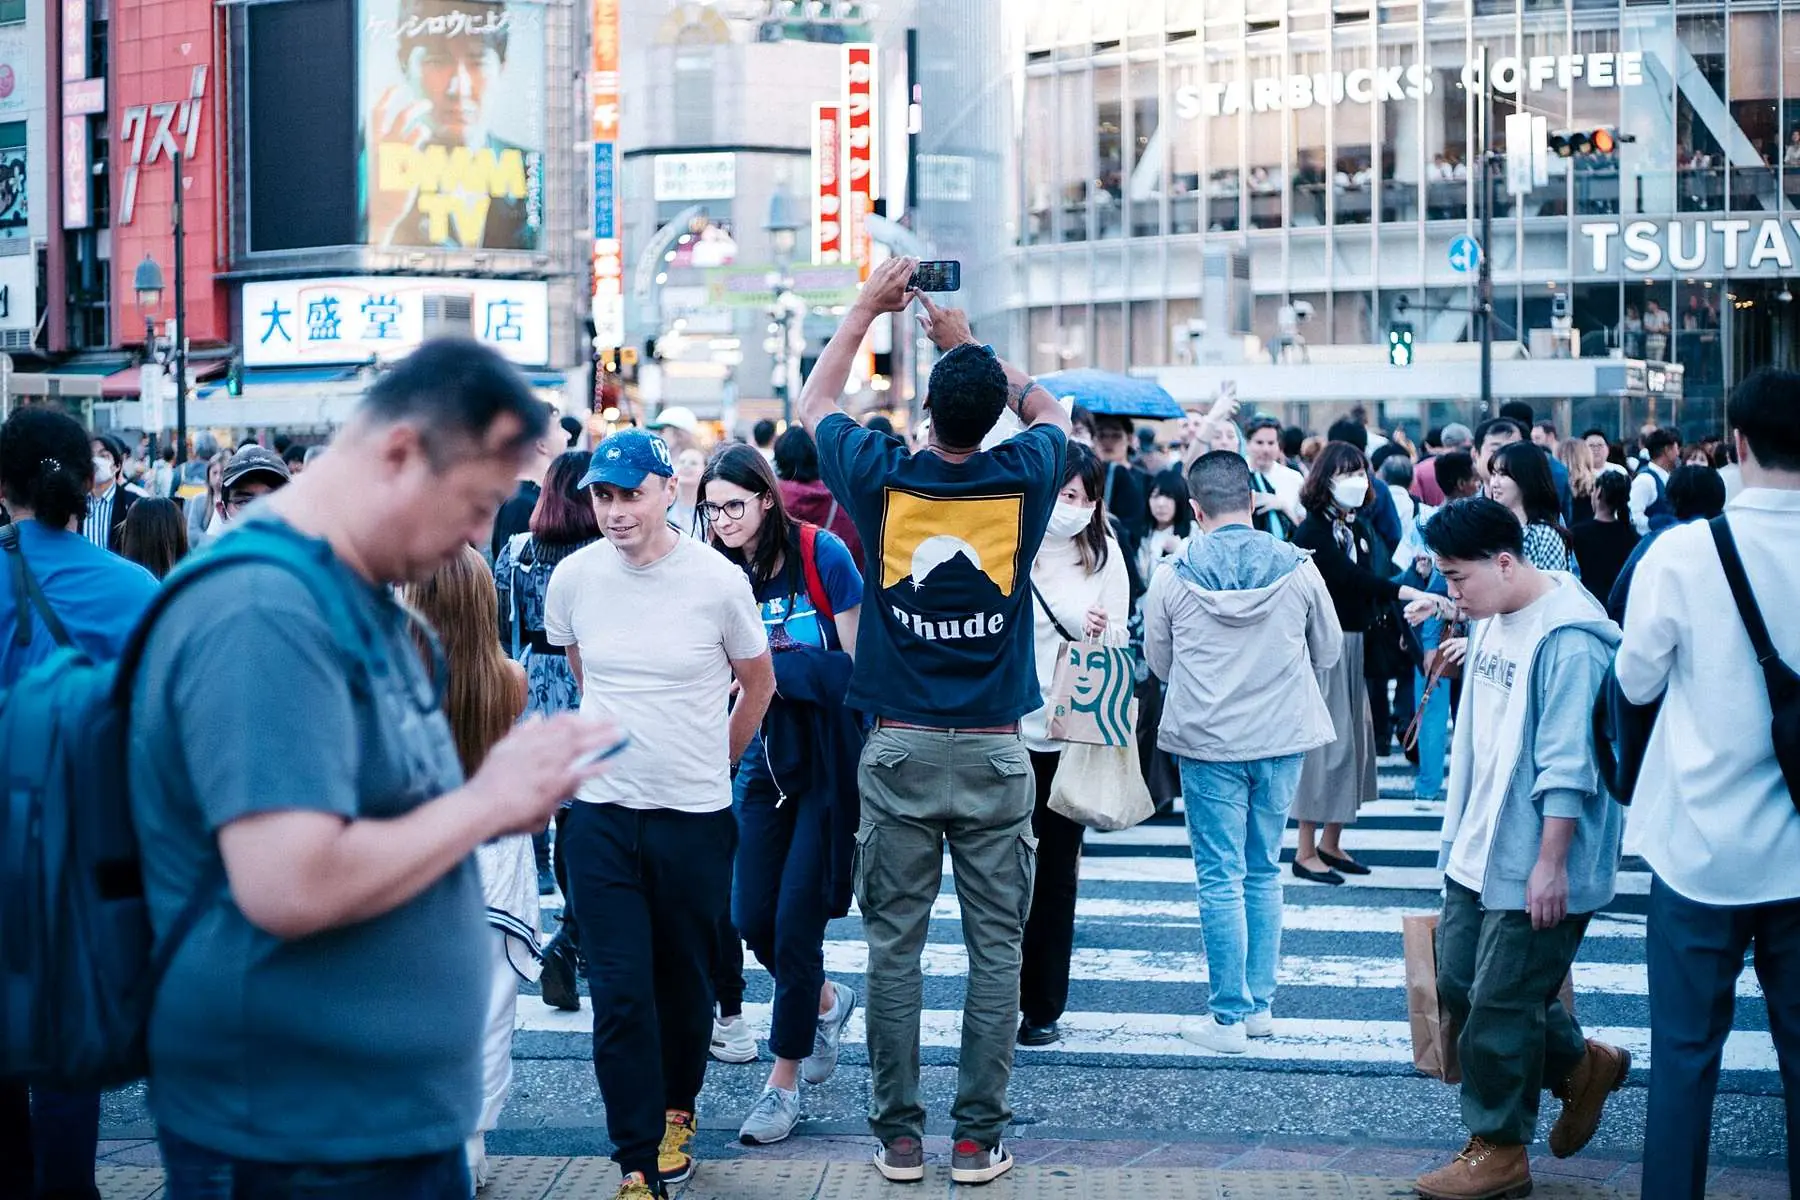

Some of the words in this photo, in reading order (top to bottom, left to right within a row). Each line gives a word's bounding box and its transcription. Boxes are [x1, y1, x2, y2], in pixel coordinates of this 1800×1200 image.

[1176, 63, 1434, 119] STARBUCKS
[1460, 52, 1644, 95] COFFEE
[379, 142, 527, 199] DMM
[418, 192, 491, 248] TV
[1581, 219, 1800, 272] TSUTA
[261, 294, 525, 344] 大盛堂店
